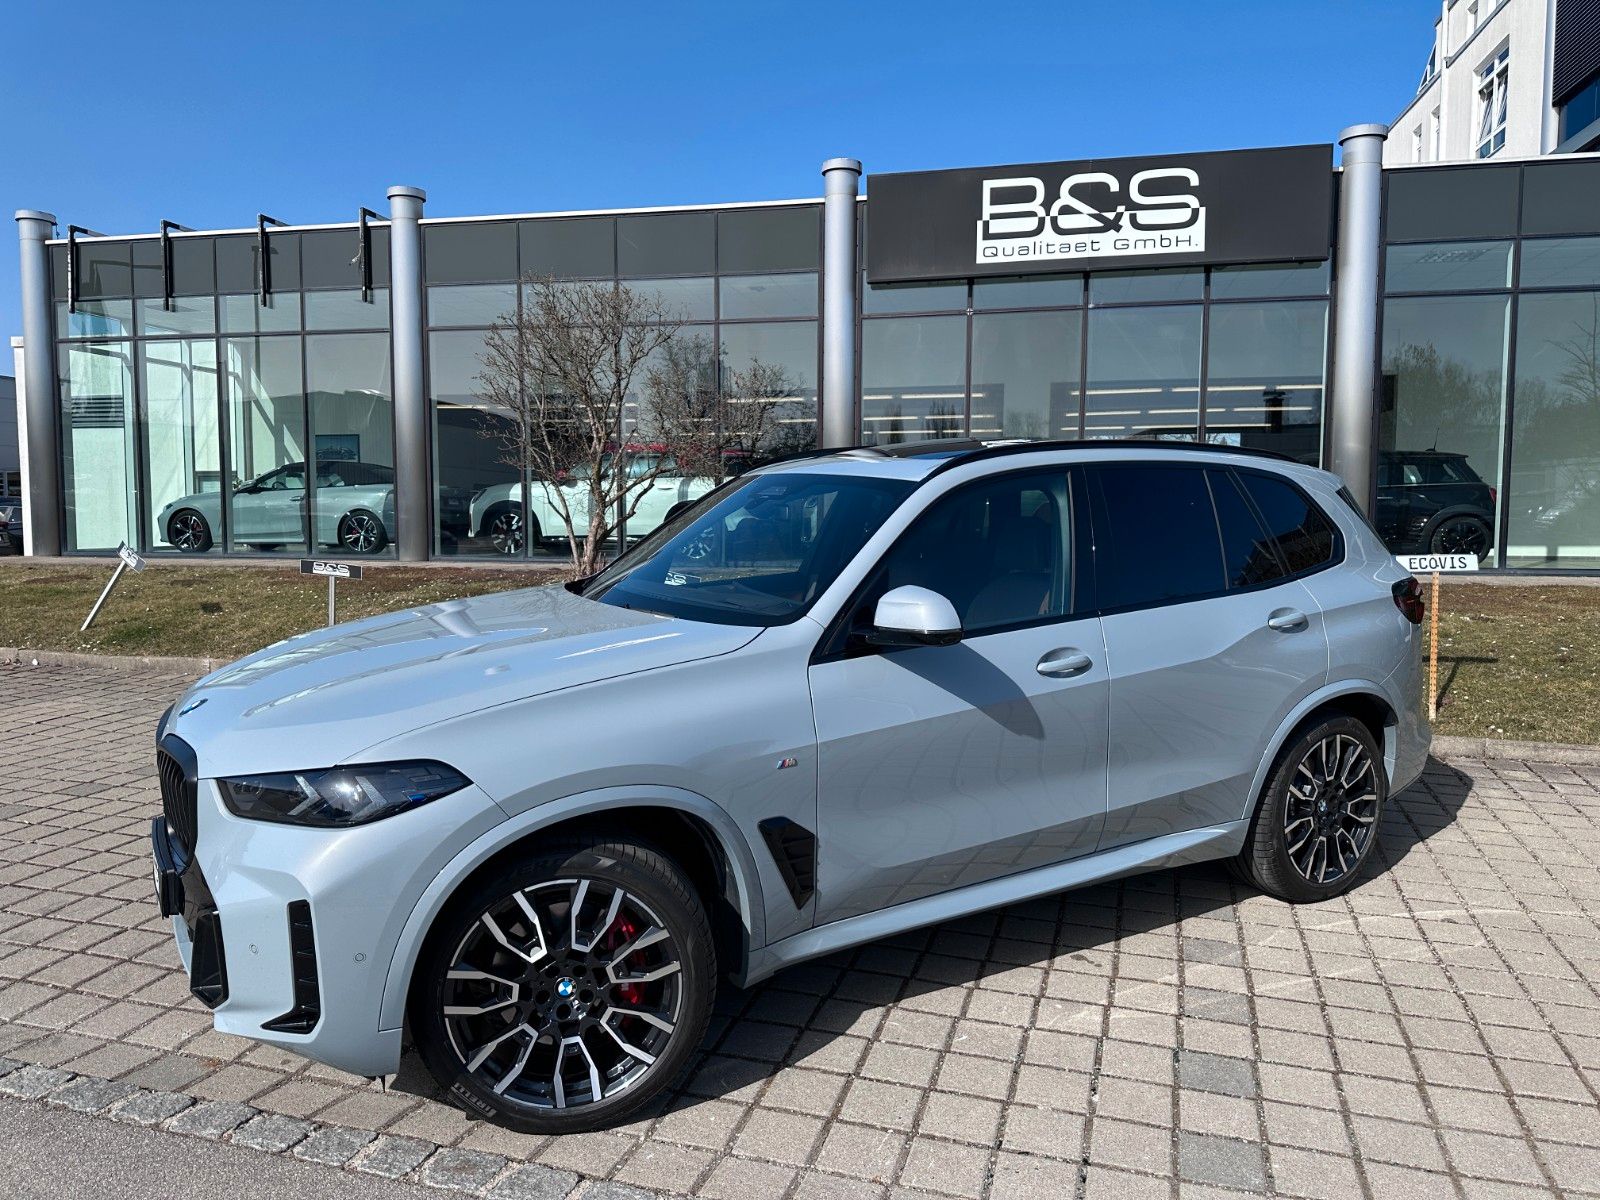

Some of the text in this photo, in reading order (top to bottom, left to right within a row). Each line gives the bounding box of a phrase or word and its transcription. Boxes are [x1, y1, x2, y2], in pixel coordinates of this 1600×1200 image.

[982, 167, 1200, 240] B&S
[983, 239, 1101, 257] Qualitaet
[313, 561, 350, 576] B&S
[1409, 556, 1467, 570] ECOVIS
